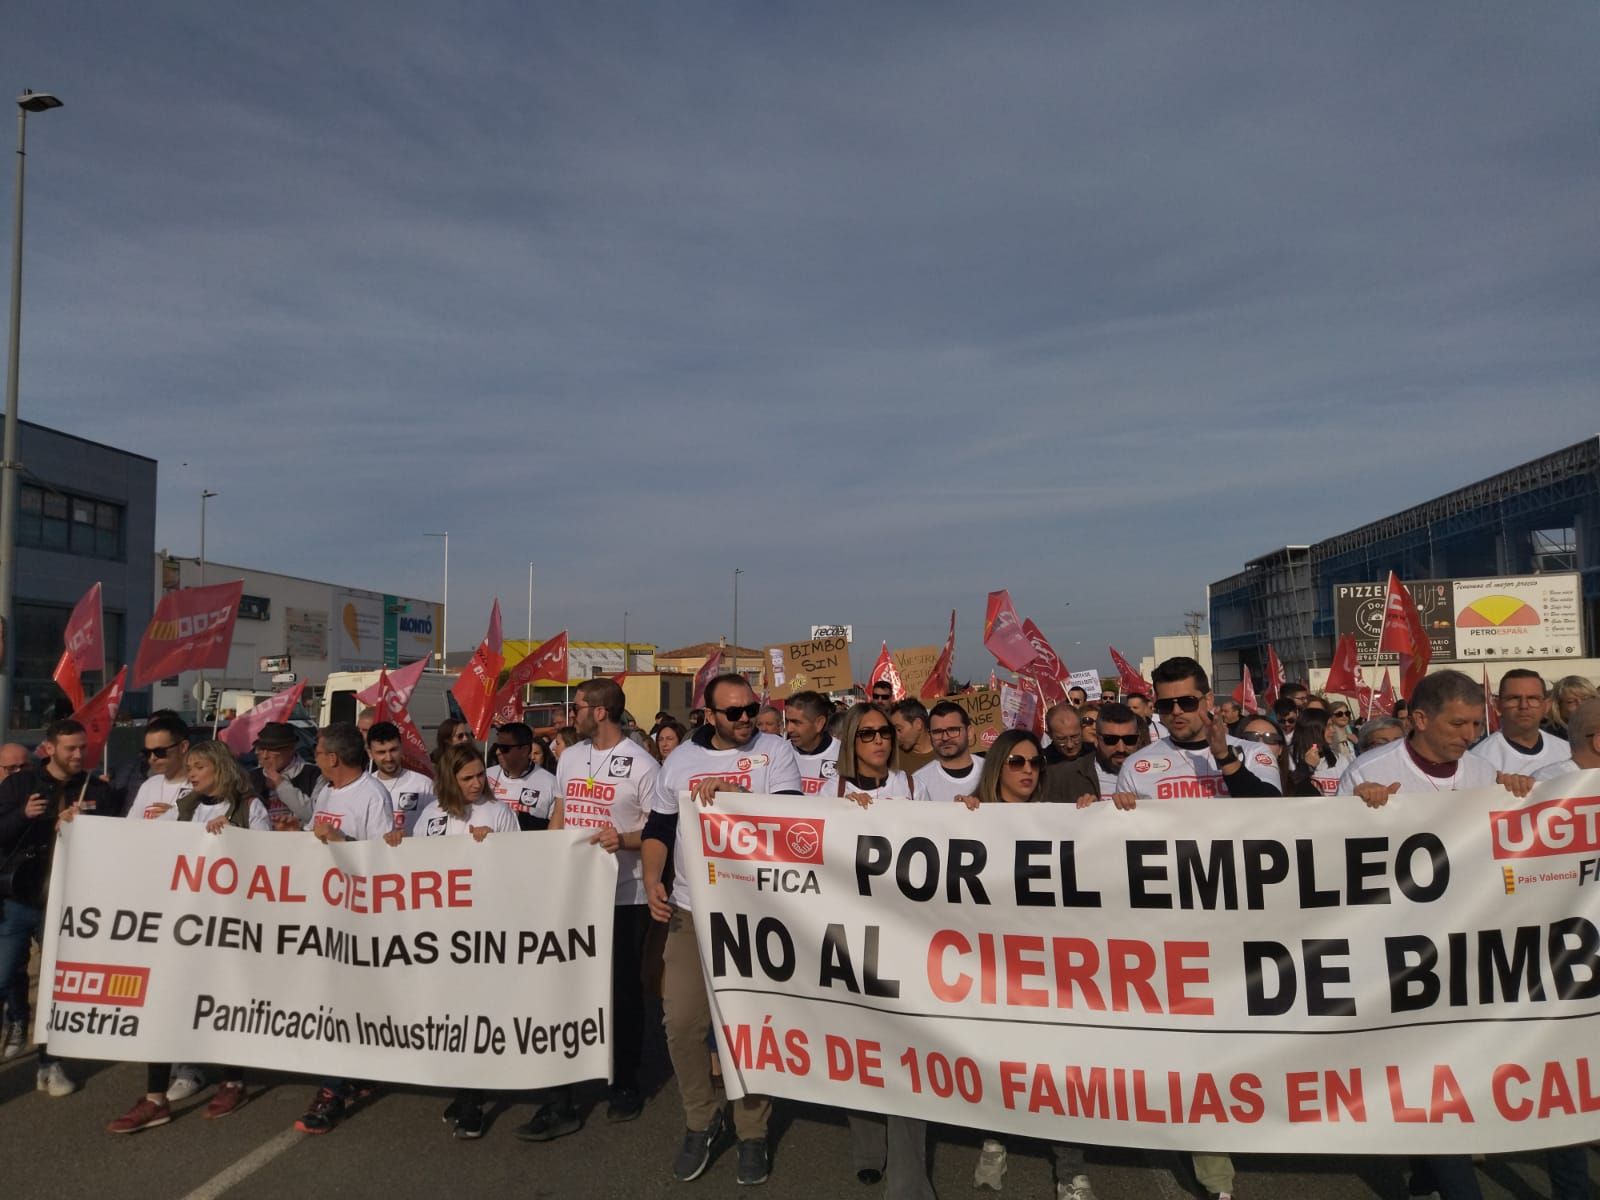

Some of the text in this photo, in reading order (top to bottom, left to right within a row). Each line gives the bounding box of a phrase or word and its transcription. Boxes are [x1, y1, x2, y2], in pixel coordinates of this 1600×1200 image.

[400, 615, 432, 634] MONTÓ
[790, 638, 845, 660] BIMBO
[801, 655, 838, 672] SIN
[811, 675, 836, 688] TI
[567, 783, 615, 801] BIMBO
[567, 804, 611, 816] SE LLEVA
[703, 819, 780, 857] UGT
[1497, 804, 1600, 852] UGT
[171, 854, 473, 914] NO AL CIERRE
[757, 867, 821, 895] FICA
[855, 832, 1450, 910] POR EL EMPLEO
[1539, 870, 1577, 882] Valencià
[110, 908, 163, 944] DE
[173, 914, 262, 953] CIEN
[277, 925, 439, 967] FAMILIAS
[450, 930, 506, 964] SIN
[517, 925, 597, 965] PAN
[710, 912, 1600, 1016] NO AL CIERRE DE BIMB
[193, 995, 606, 1059] Panificación Industrial De Vergel
[723, 1015, 811, 1076] MÁS
[825, 1034, 885, 1088] DE
[900, 1047, 983, 1104] 100
[1000, 1061, 1265, 1123] FAMILIAS
[1285, 1068, 1367, 1124] EN
[1386, 1064, 1475, 1124] LA
